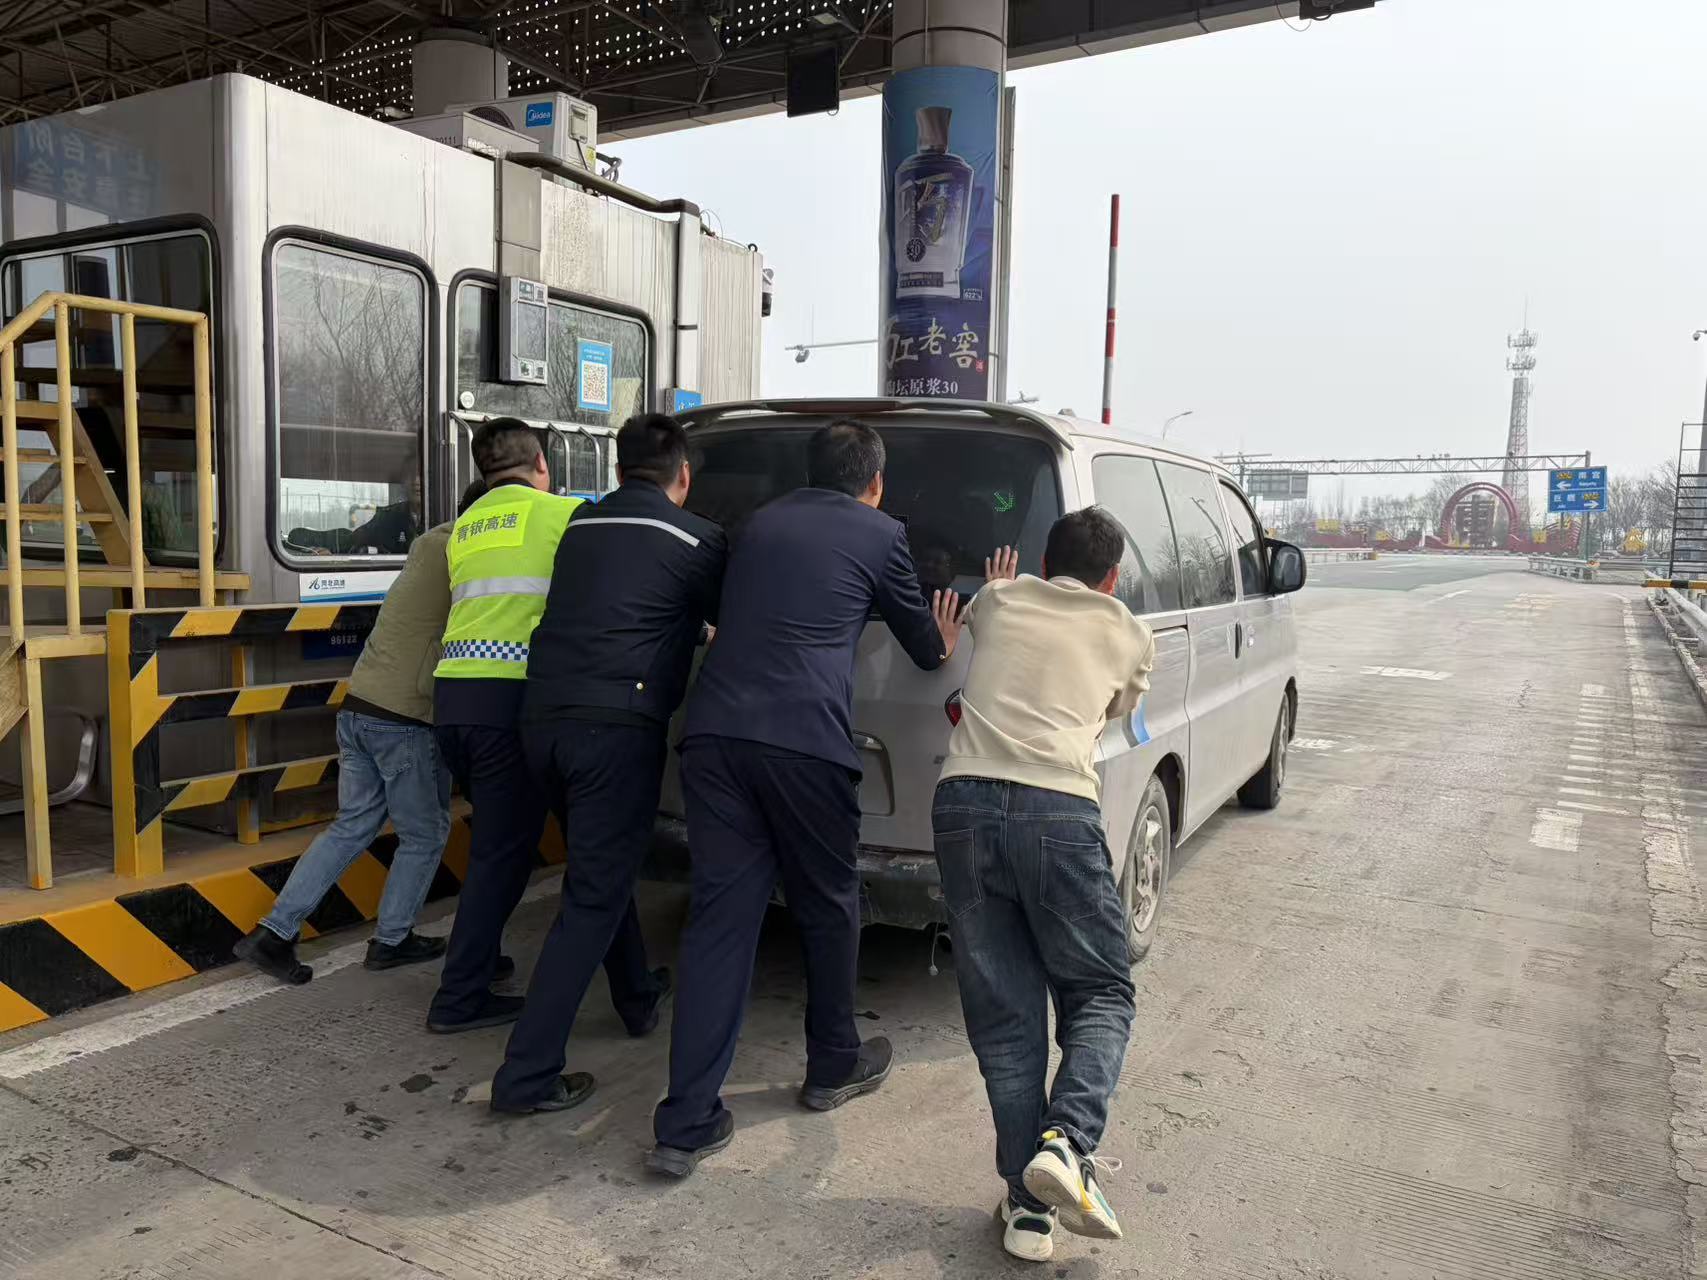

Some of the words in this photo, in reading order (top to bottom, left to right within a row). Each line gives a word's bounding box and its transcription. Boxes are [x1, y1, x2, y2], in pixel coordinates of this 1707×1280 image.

[527, 109, 551, 121] Midea
[457, 512, 519, 543] 青银高速
